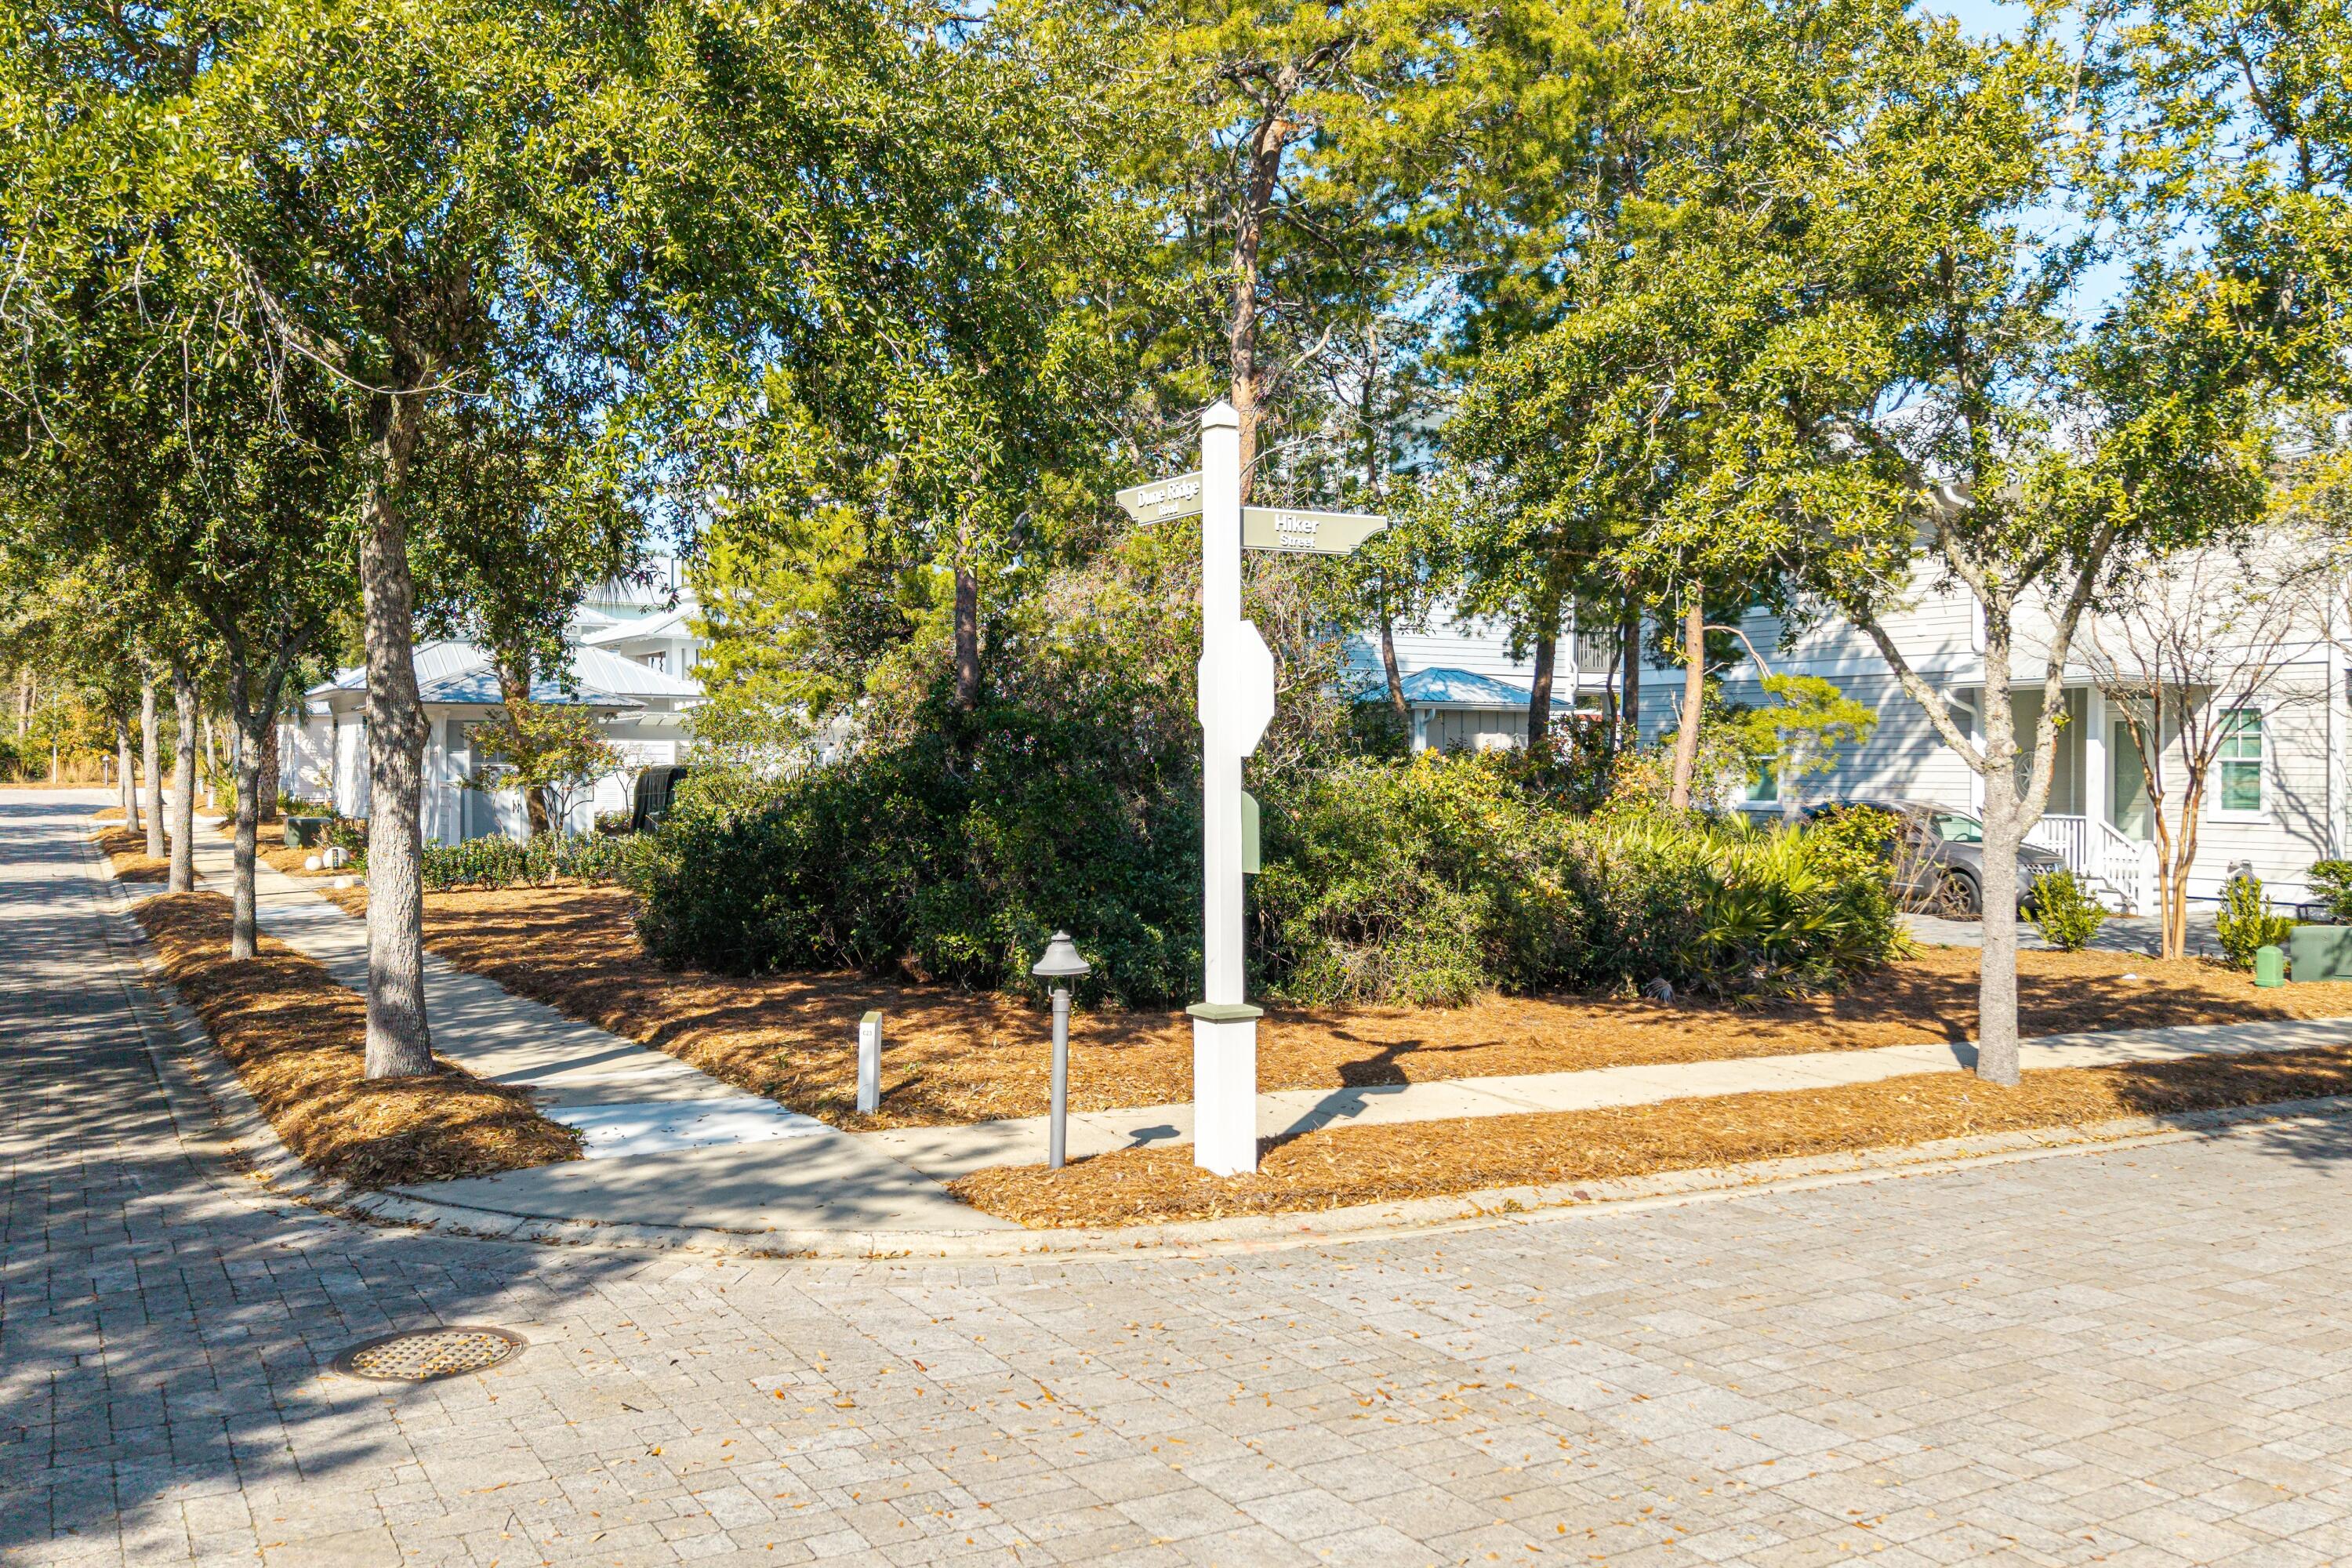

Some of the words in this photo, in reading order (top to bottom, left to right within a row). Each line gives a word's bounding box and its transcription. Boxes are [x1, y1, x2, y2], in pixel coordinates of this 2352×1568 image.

[1138, 489, 1165, 507] Dune
[1167, 480, 1200, 506] Ridge
[1159, 502, 1178, 517] Road
[1276, 514, 1319, 534] Hiker
[1279, 534, 1316, 548] Street
